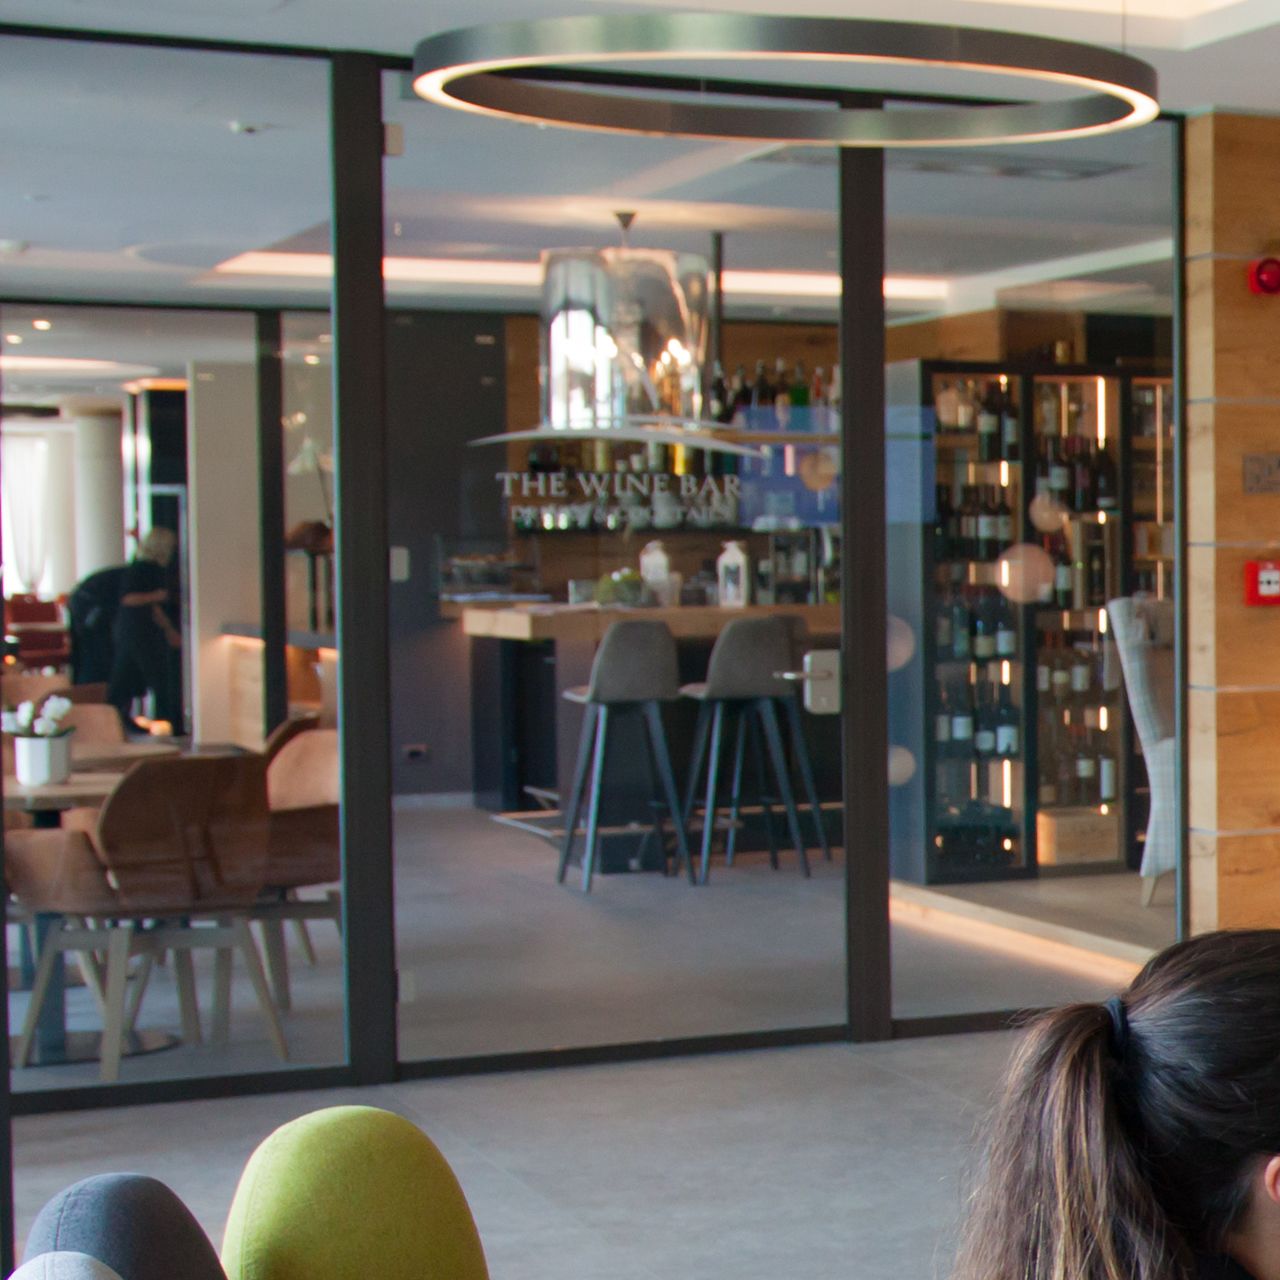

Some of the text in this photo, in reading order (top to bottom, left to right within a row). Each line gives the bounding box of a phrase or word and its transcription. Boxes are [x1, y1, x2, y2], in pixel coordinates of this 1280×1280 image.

[496, 472, 741, 498] THE WINE BAR
